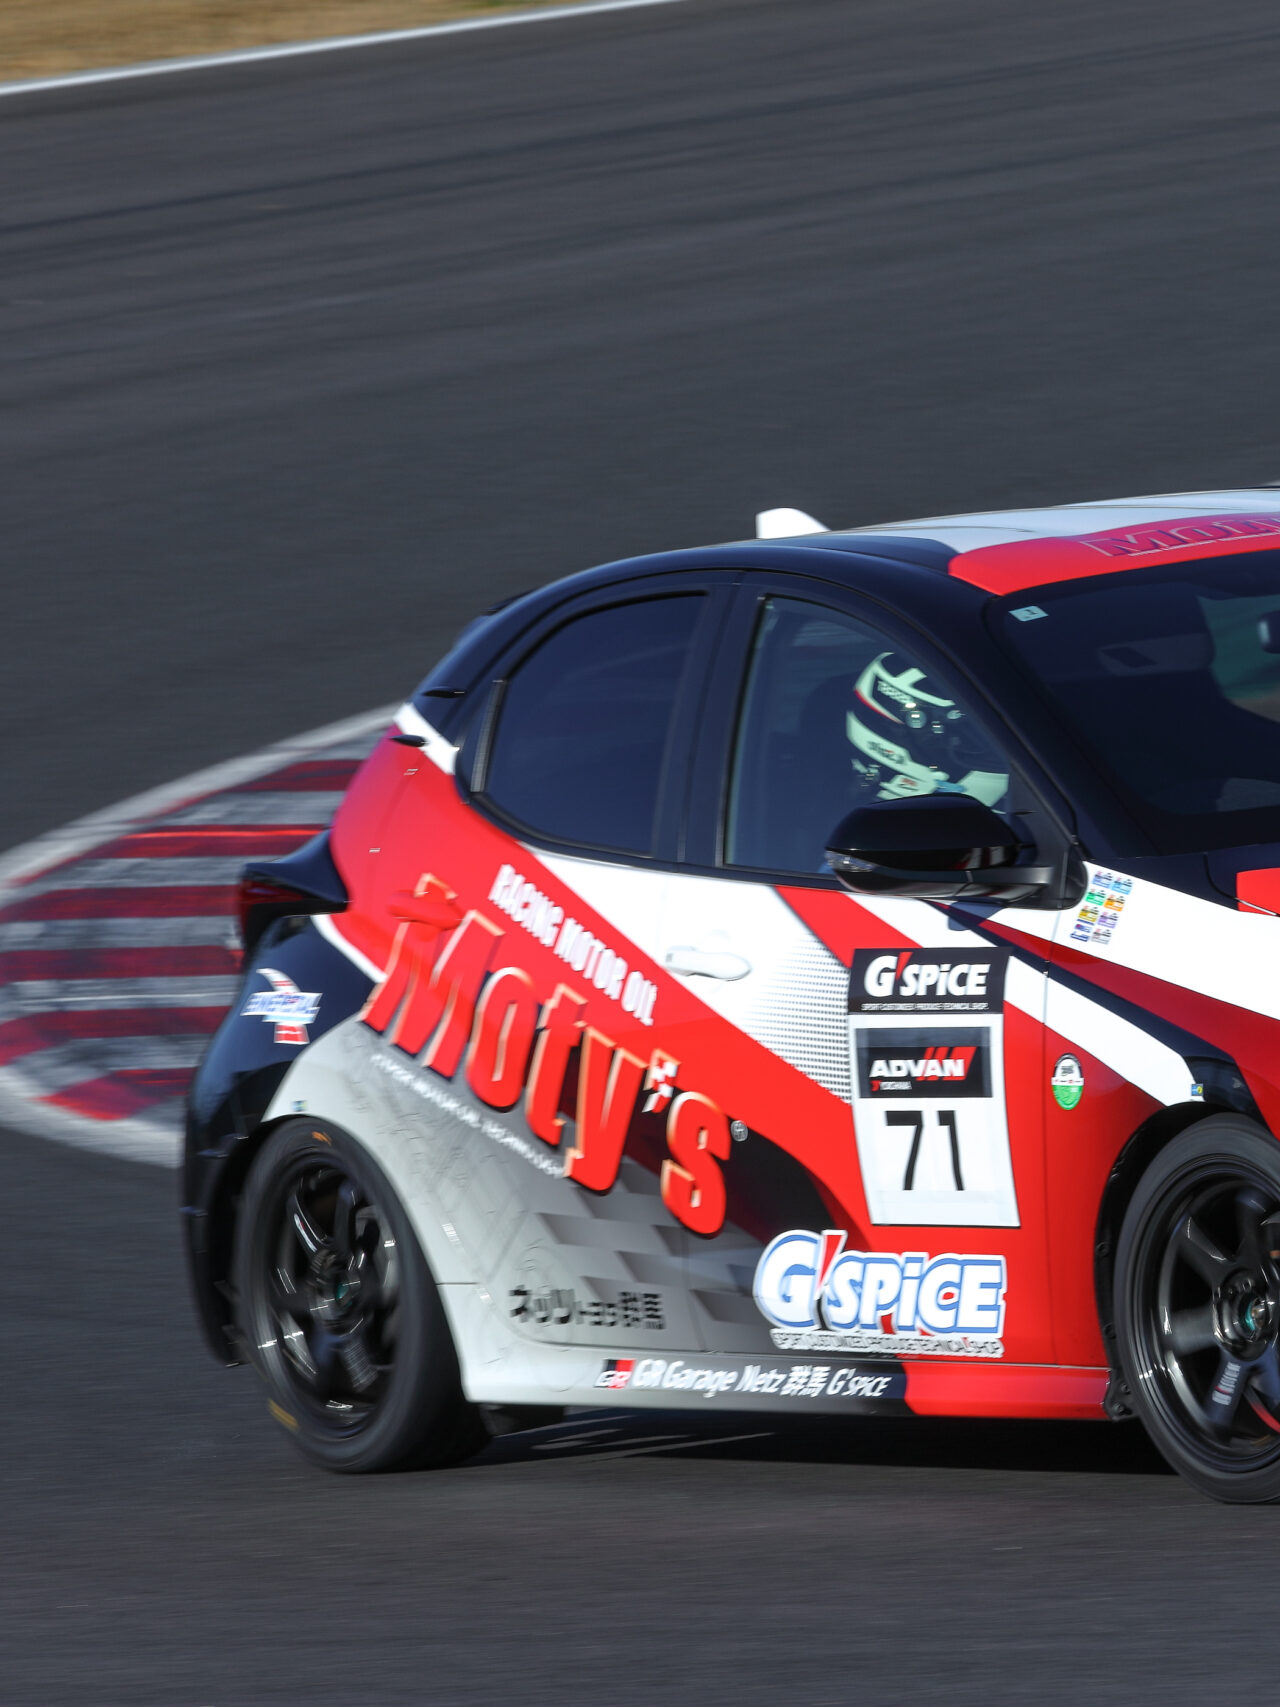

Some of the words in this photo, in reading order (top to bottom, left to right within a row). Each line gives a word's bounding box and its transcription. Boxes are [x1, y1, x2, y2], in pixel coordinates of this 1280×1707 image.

[356, 872, 732, 1238] Moty's
[868, 1058, 966, 1078] ADVAN
[884, 1109, 965, 1191] 71
[632, 1359, 668, 1388] GR
[661, 1360, 739, 1398] Garage
[735, 1364, 787, 1393] Netz
